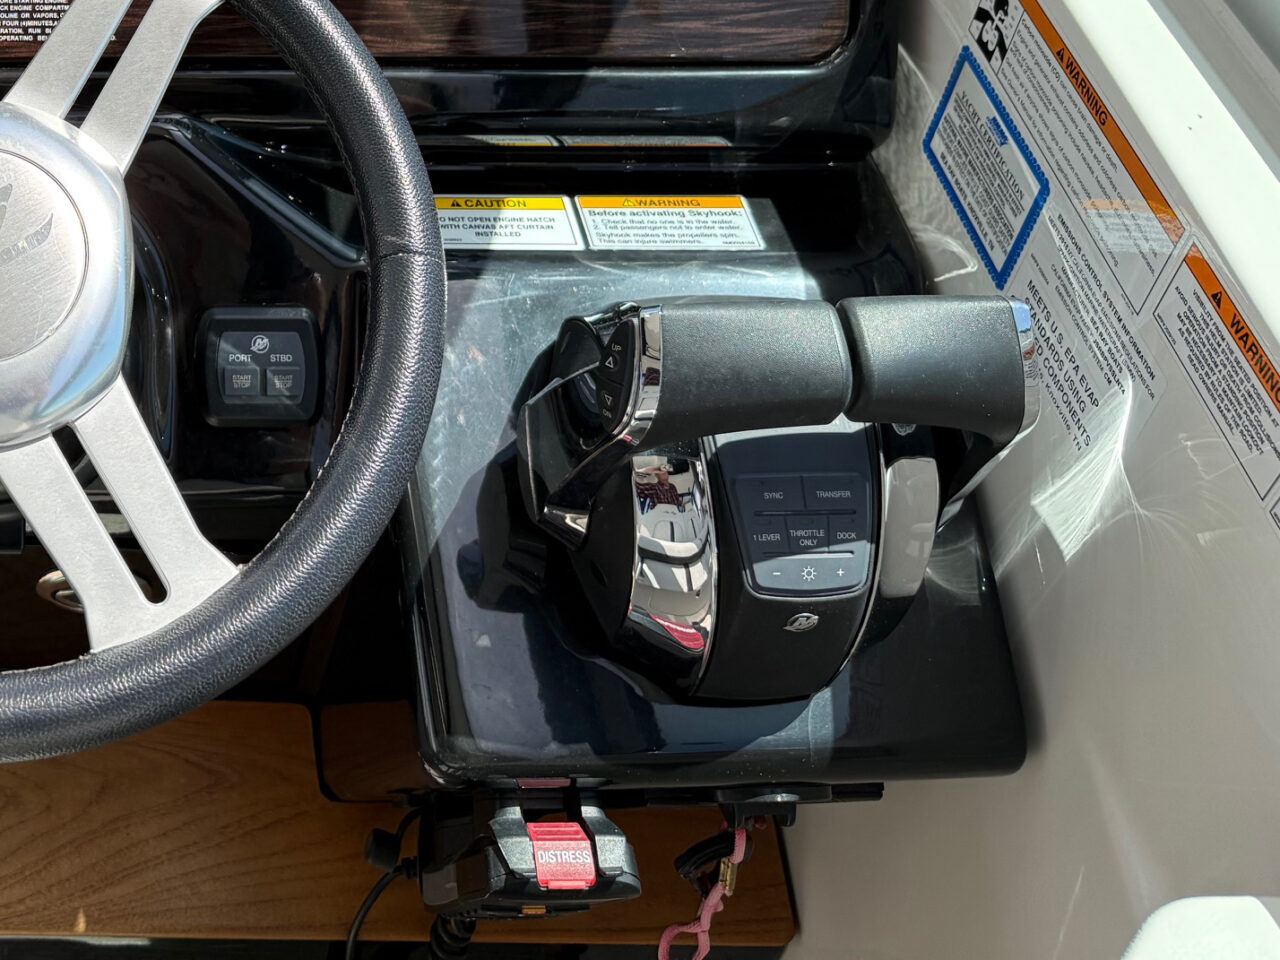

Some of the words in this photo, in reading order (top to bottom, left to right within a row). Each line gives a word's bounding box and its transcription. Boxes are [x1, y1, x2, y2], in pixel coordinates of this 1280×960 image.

[1064, 55, 1108, 127] WARNING
[960, 89, 980, 126] YACHT
[978, 121, 1024, 203] CERTIFICATION
[465, 199, 527, 207] CAUTION
[629, 209, 686, 219] activating
[688, 209, 742, 218] Skyhook:
[635, 199, 700, 207] WARNING
[1057, 212, 1082, 255] EMISSIONS
[1080, 251, 1103, 292] CONTROL
[1102, 289, 1122, 324] SYSTEM
[1120, 322, 1155, 381] INFORMATION
[228, 354, 253, 362] PORT
[270, 354, 293, 362] STBD
[1026, 278, 1051, 323] MEETS
[1049, 320, 1066, 349] U.S.
[1063, 345, 1081, 377] EPA
[1078, 372, 1100, 411] EVAP
[1054, 284, 1073, 316] EMISSION
[1070, 313, 1089, 345] CONTROL
[1103, 370, 1112, 386] CM
[1106, 346, 1123, 374] BOATS
[1174, 284, 1188, 306] AVOID
[1186, 304, 1206, 335] SERIOUS
[1204, 333, 1220, 359] INJURY
[1225, 368, 1242, 394] DEATH
[1240, 391, 1255, 415] FROM
[1183, 335, 1205, 371] REQUIRED
[1209, 379, 1225, 404] RULES
[1191, 289, 1213, 323] VISIBILITY
[1211, 320, 1226, 343] FROM
[1224, 341, 1234, 357] THE
[1232, 355, 1251, 384] SEATED
[1249, 382, 1272, 418] POSITION
[1198, 312, 1210, 329] THIS
[1208, 327, 1222, 349] HELM
[1220, 347, 1239, 378] STATION
[1243, 384, 1263, 416] LIMITED.
[1042, 355, 1091, 448] COMPONENTS
[1062, 369, 1086, 414] USING
[1176, 312, 1186, 328] MAY
[1190, 335, 1216, 377] NECESSARY
[1220, 386, 1243, 422] MAINTAIN
[1240, 419, 1264, 457] LOOKOUT
[1181, 309, 1207, 349] OPERATION
[1205, 347, 1219, 369] FROM
[1221, 373, 1244, 410] STANDING
[1242, 408, 1265, 446] POSITION
[1186, 353, 1199, 374] READ
[1197, 371, 1217, 404] OWNERS
[1044, 381, 1072, 436] Knoxville,
[1071, 434, 1081, 452] TN
[758, 533, 781, 541] LEVER
[538, 850, 590, 864] DISTRESS
